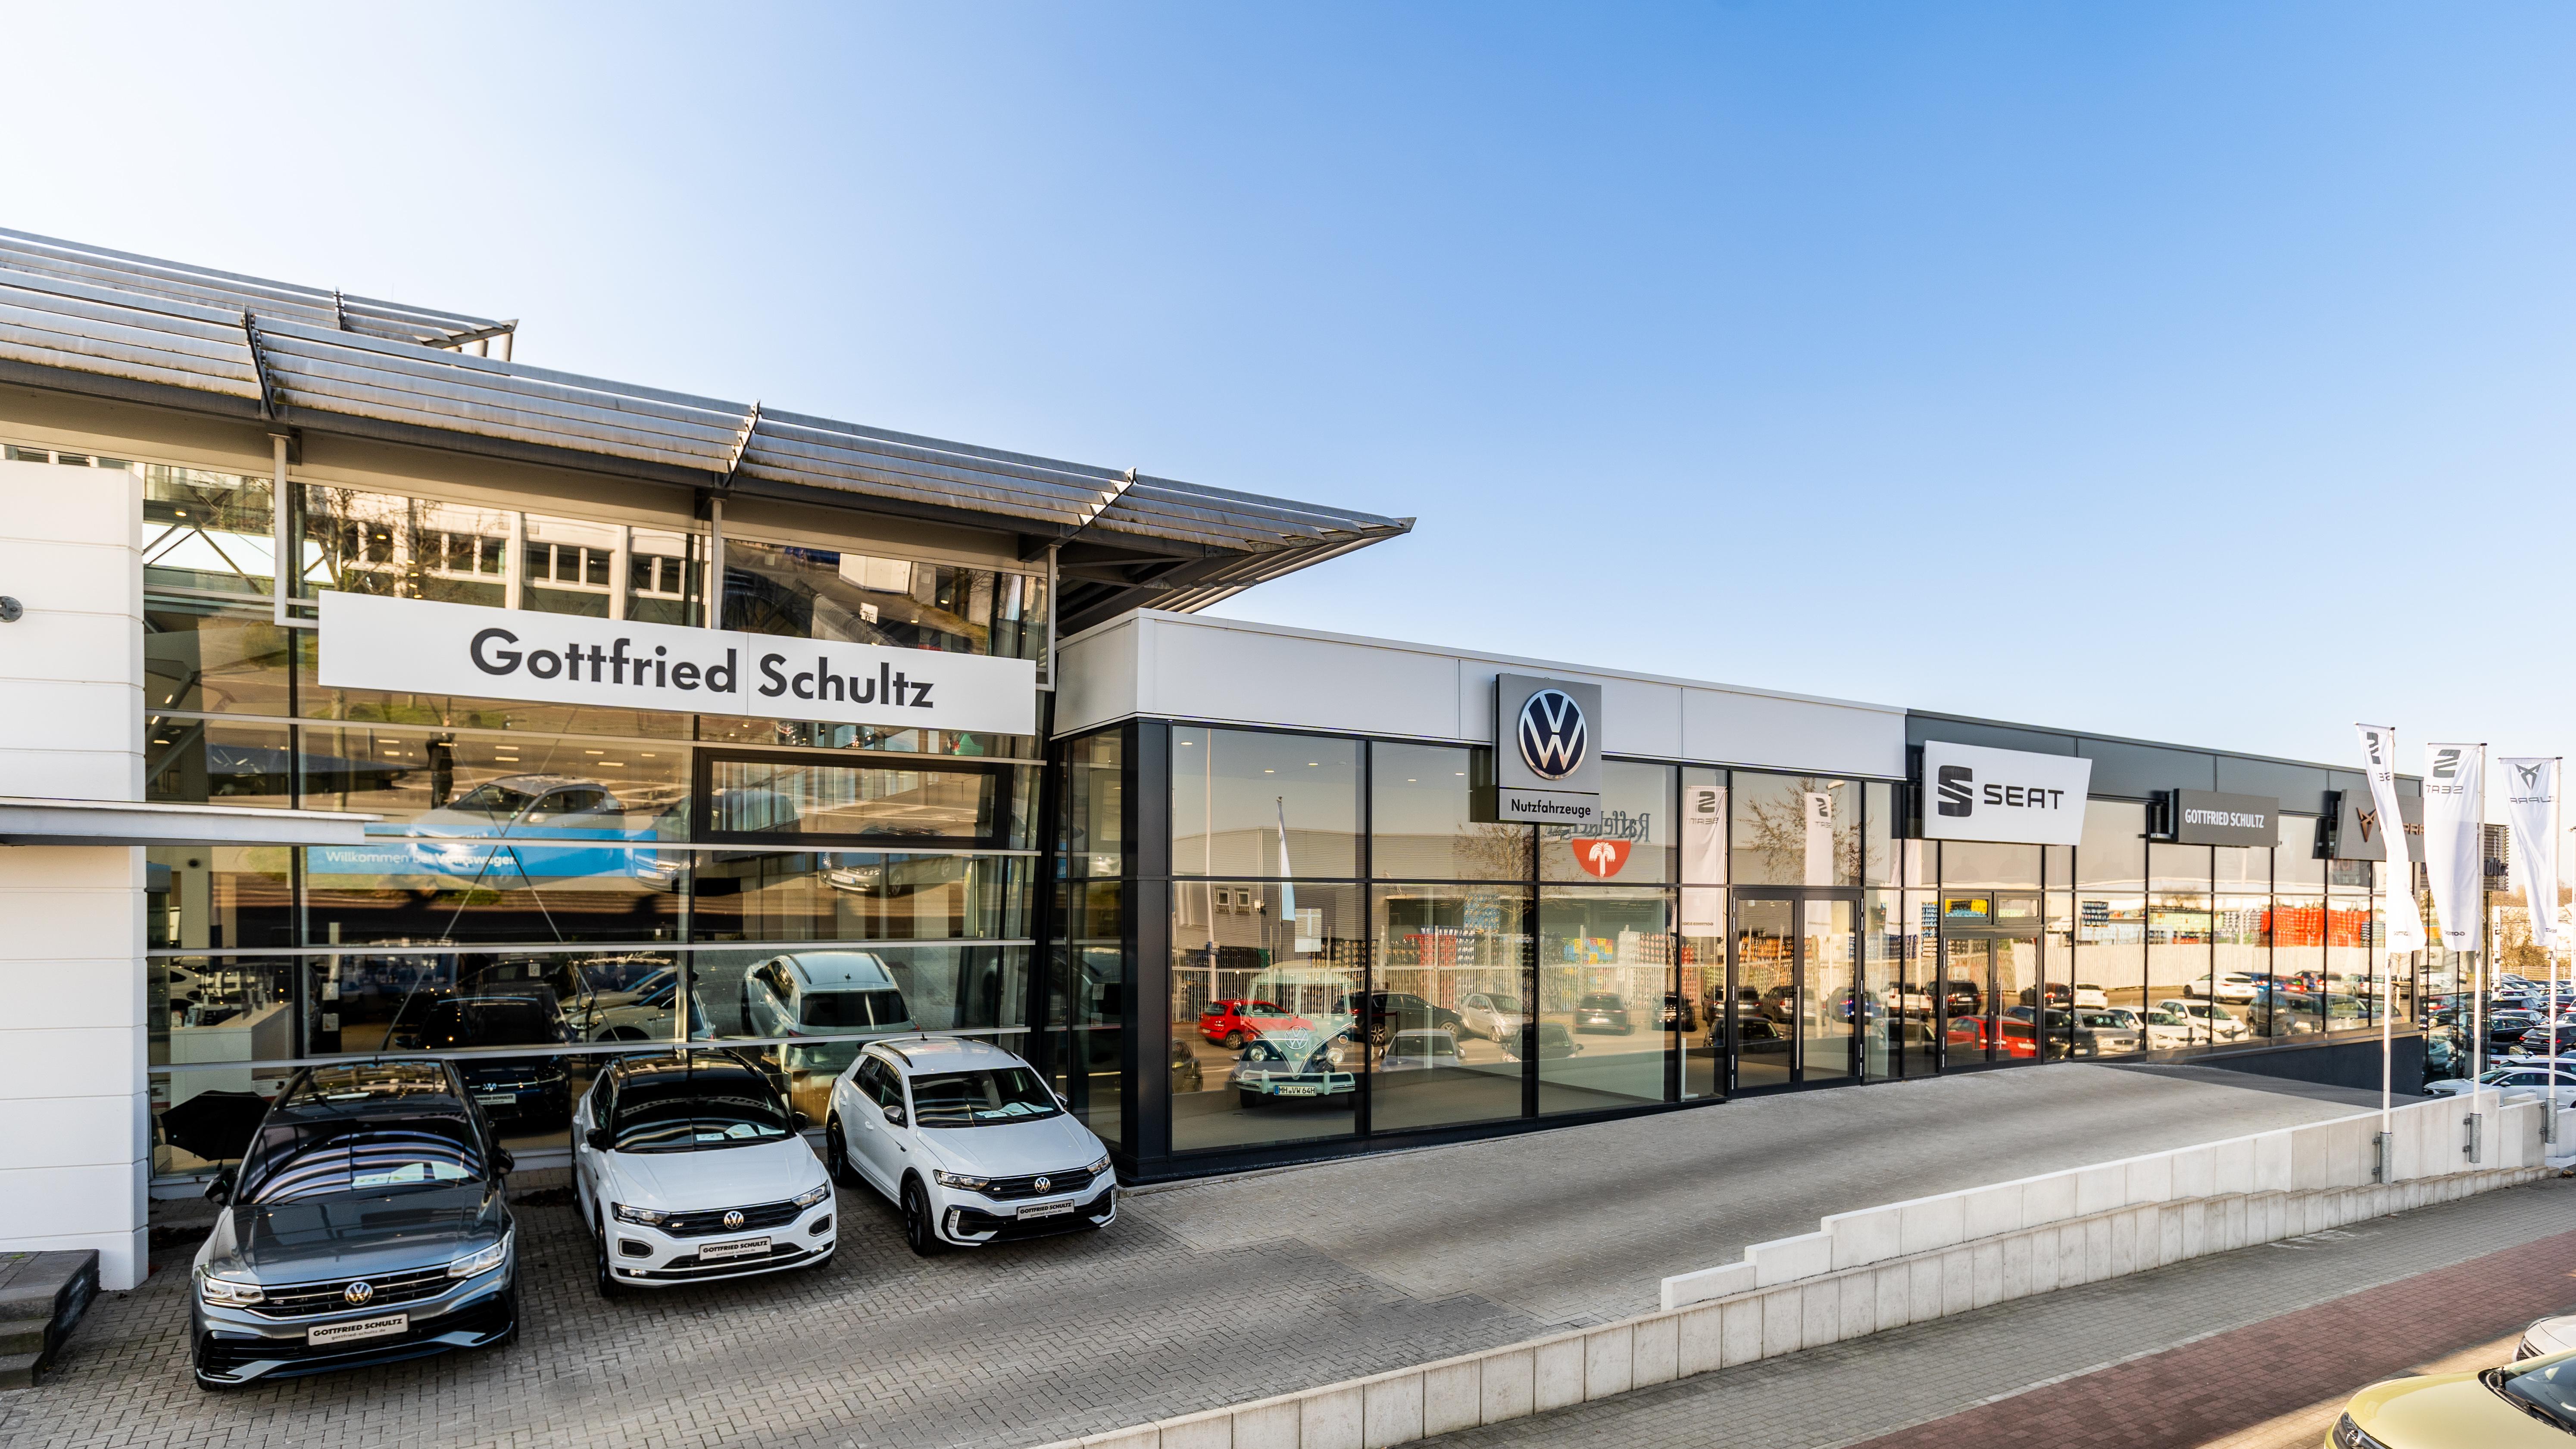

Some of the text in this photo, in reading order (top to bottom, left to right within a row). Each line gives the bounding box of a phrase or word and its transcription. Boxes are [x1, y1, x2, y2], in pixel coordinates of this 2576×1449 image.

[471, 627, 934, 708] Gottfried Schultz
[1984, 784, 2064, 809] SEAT
[1511, 799, 1591, 818] Nutzfahrzeuge
[2185, 808, 2265, 828] GOTTFRIED SCHULTZ
[326, 851, 409, 863] Willkommen
[1049, 1202, 1072, 1210] SCHULTZ
[703, 1240, 768, 1253] GOTTFRIED SCHULTZ
[313, 1318, 403, 1337] GOTTFRIED SCHULTZ
[331, 1328, 386, 1340] gottfried-schultz.de
